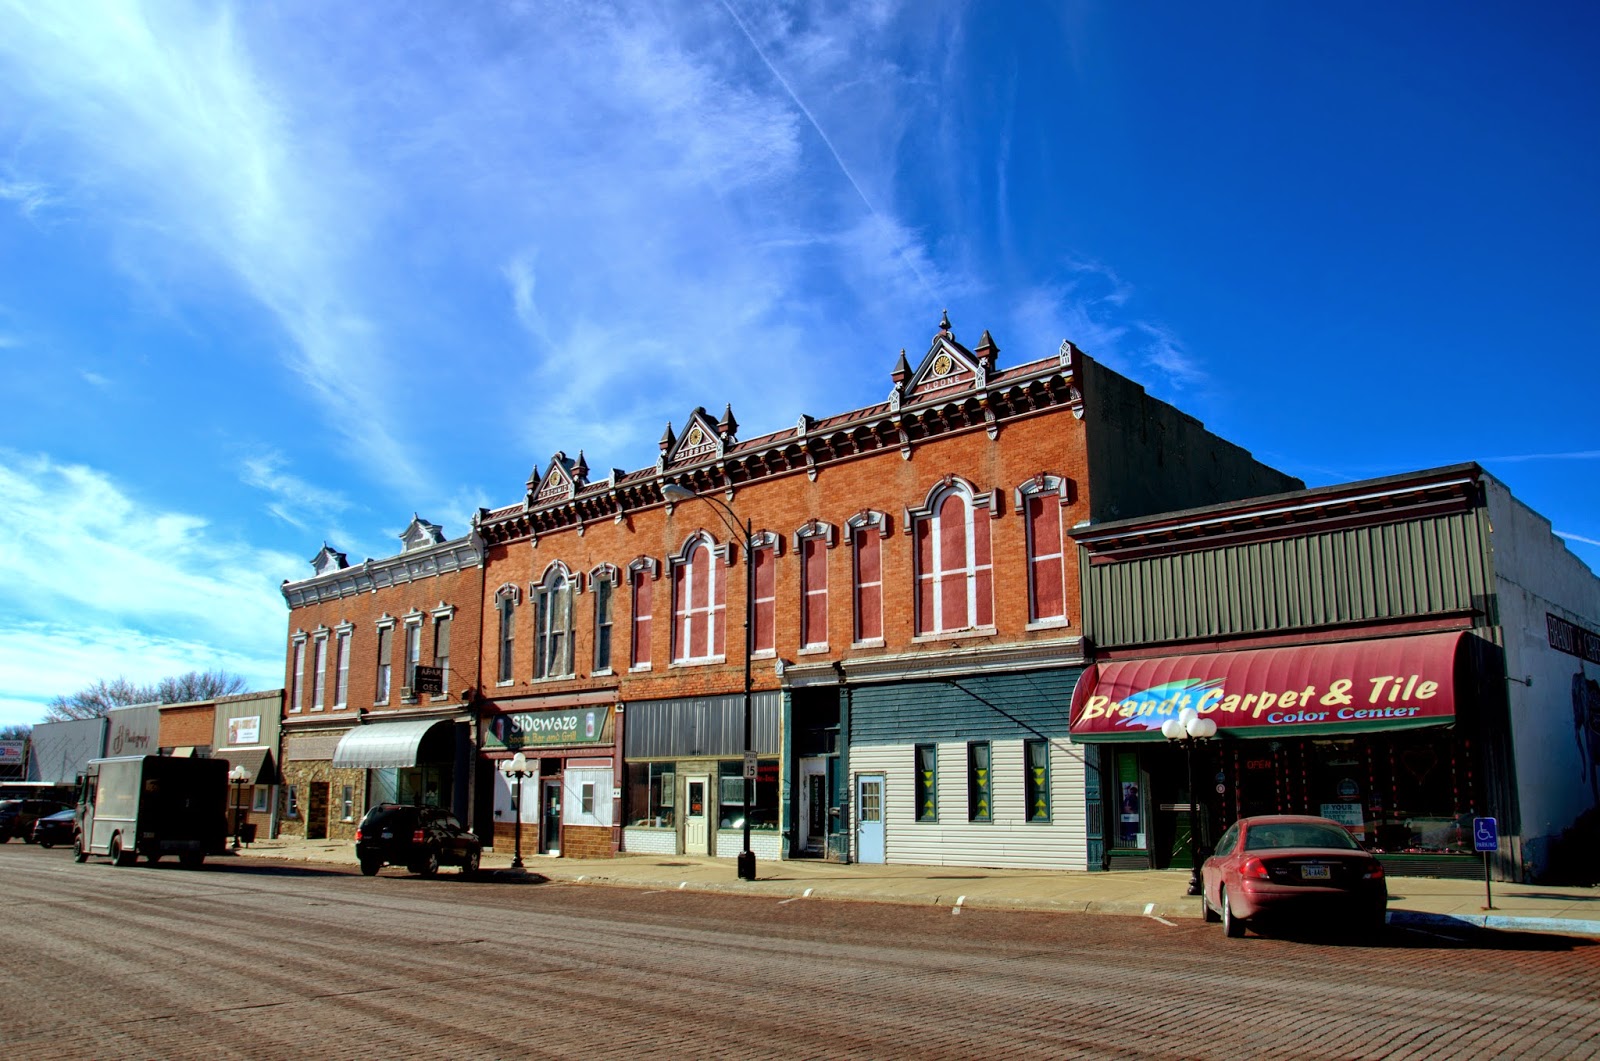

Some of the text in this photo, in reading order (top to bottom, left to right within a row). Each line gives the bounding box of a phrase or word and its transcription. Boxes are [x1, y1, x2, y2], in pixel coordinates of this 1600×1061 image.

[1081, 674, 1439, 720] Brandt Carpet & Tile
[1267, 706, 1421, 724] Color Center
[511, 714, 578, 733] Sidewaze
[509, 730, 577, 743] Sports Bar and Grill
[746, 765, 755, 776] 15
[1246, 759, 1272, 770] OPEN
